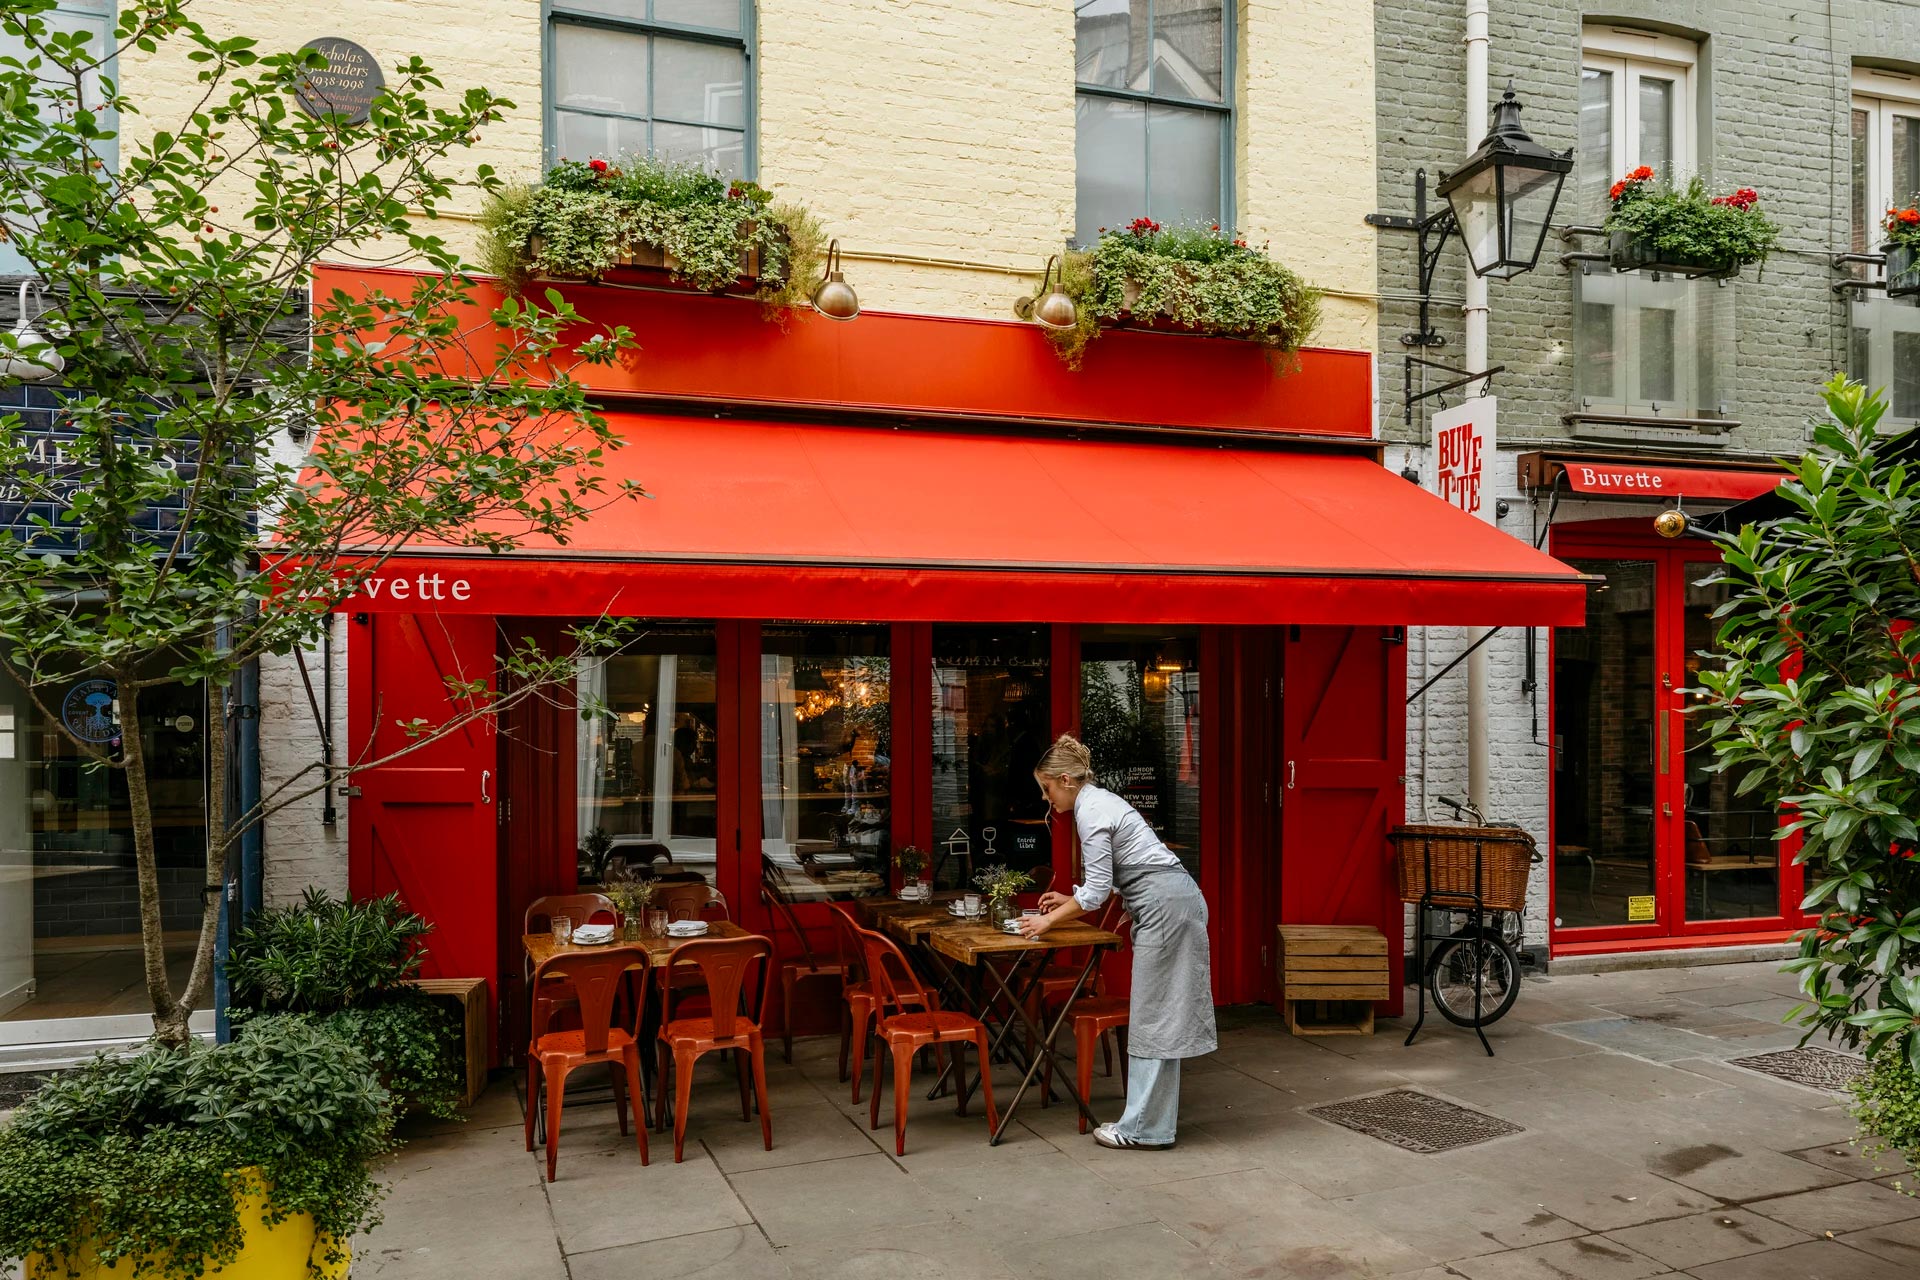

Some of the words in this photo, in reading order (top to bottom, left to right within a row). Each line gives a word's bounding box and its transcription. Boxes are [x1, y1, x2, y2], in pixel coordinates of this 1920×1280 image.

[305, 63, 369, 77] unders
[311, 76, 365, 91] 1938-1998
[1437, 422, 1482, 474] BUVE
[1580, 467, 1663, 488] Buvette
